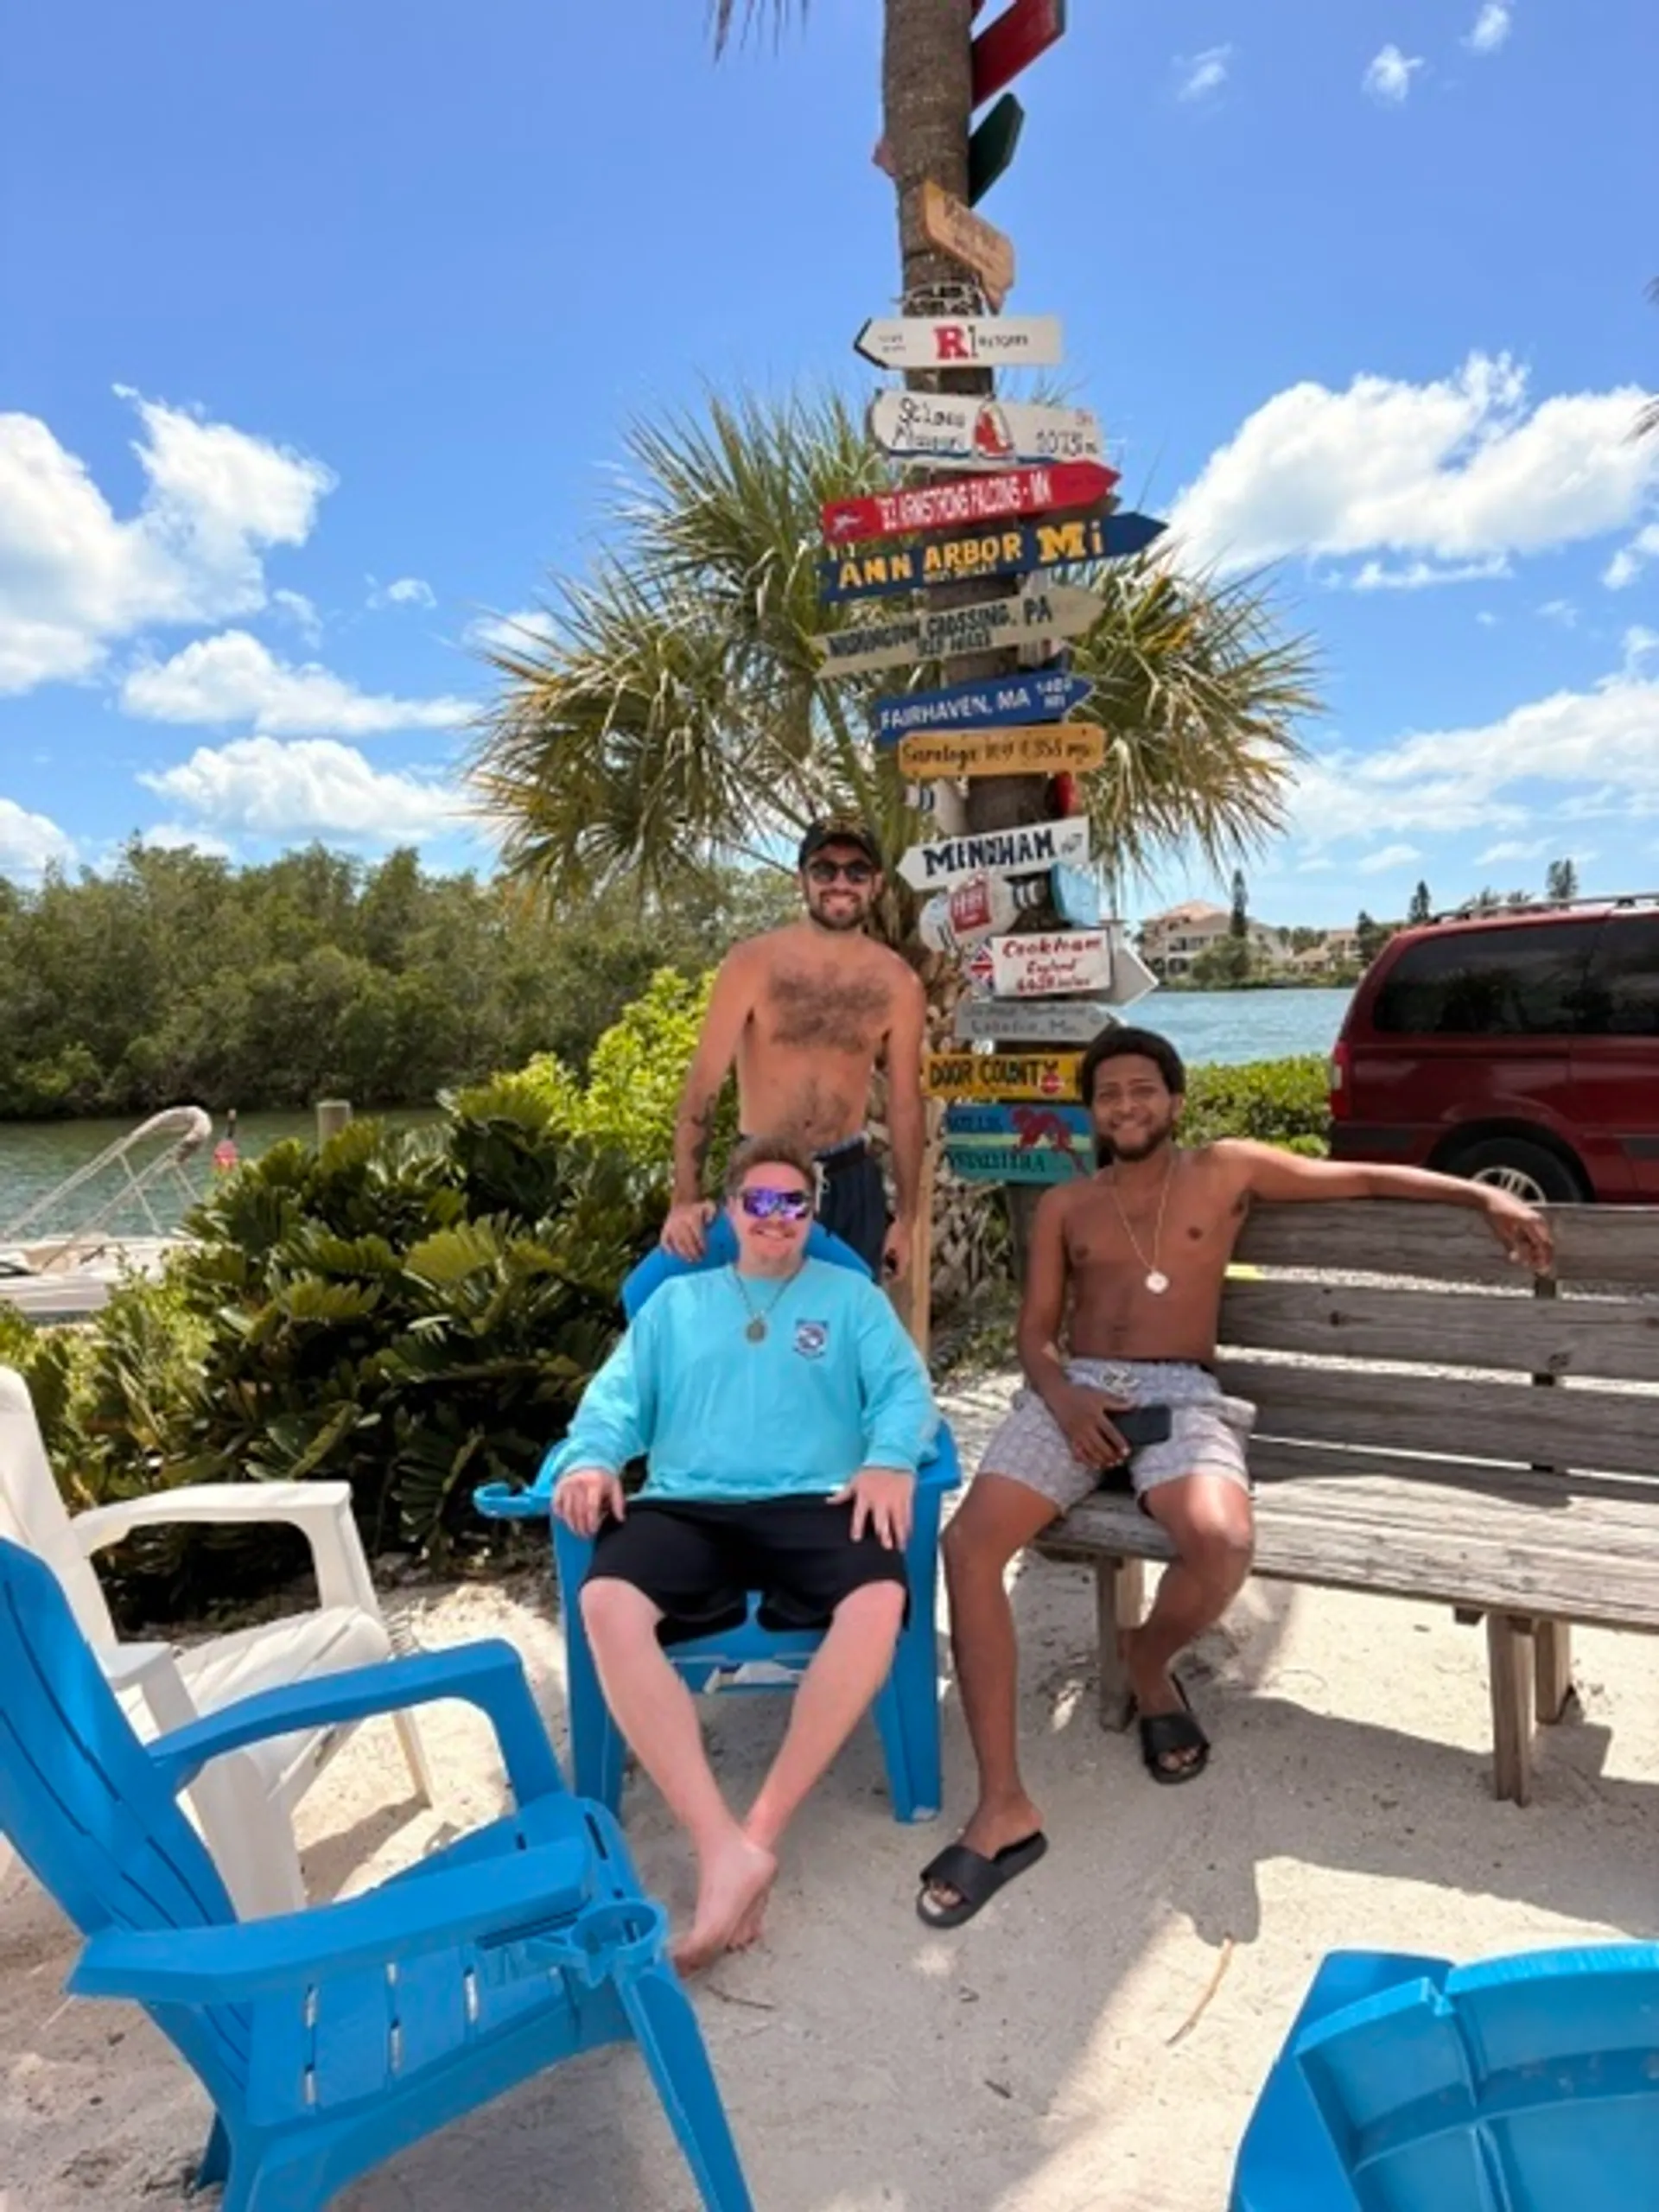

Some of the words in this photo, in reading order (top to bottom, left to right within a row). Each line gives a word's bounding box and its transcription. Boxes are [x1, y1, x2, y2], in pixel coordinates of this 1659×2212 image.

[838, 554, 913, 589] ANN
[922, 531, 1023, 571] ARBOR
[1023, 594, 1052, 626] PA
[996, 687, 1032, 711] MA
